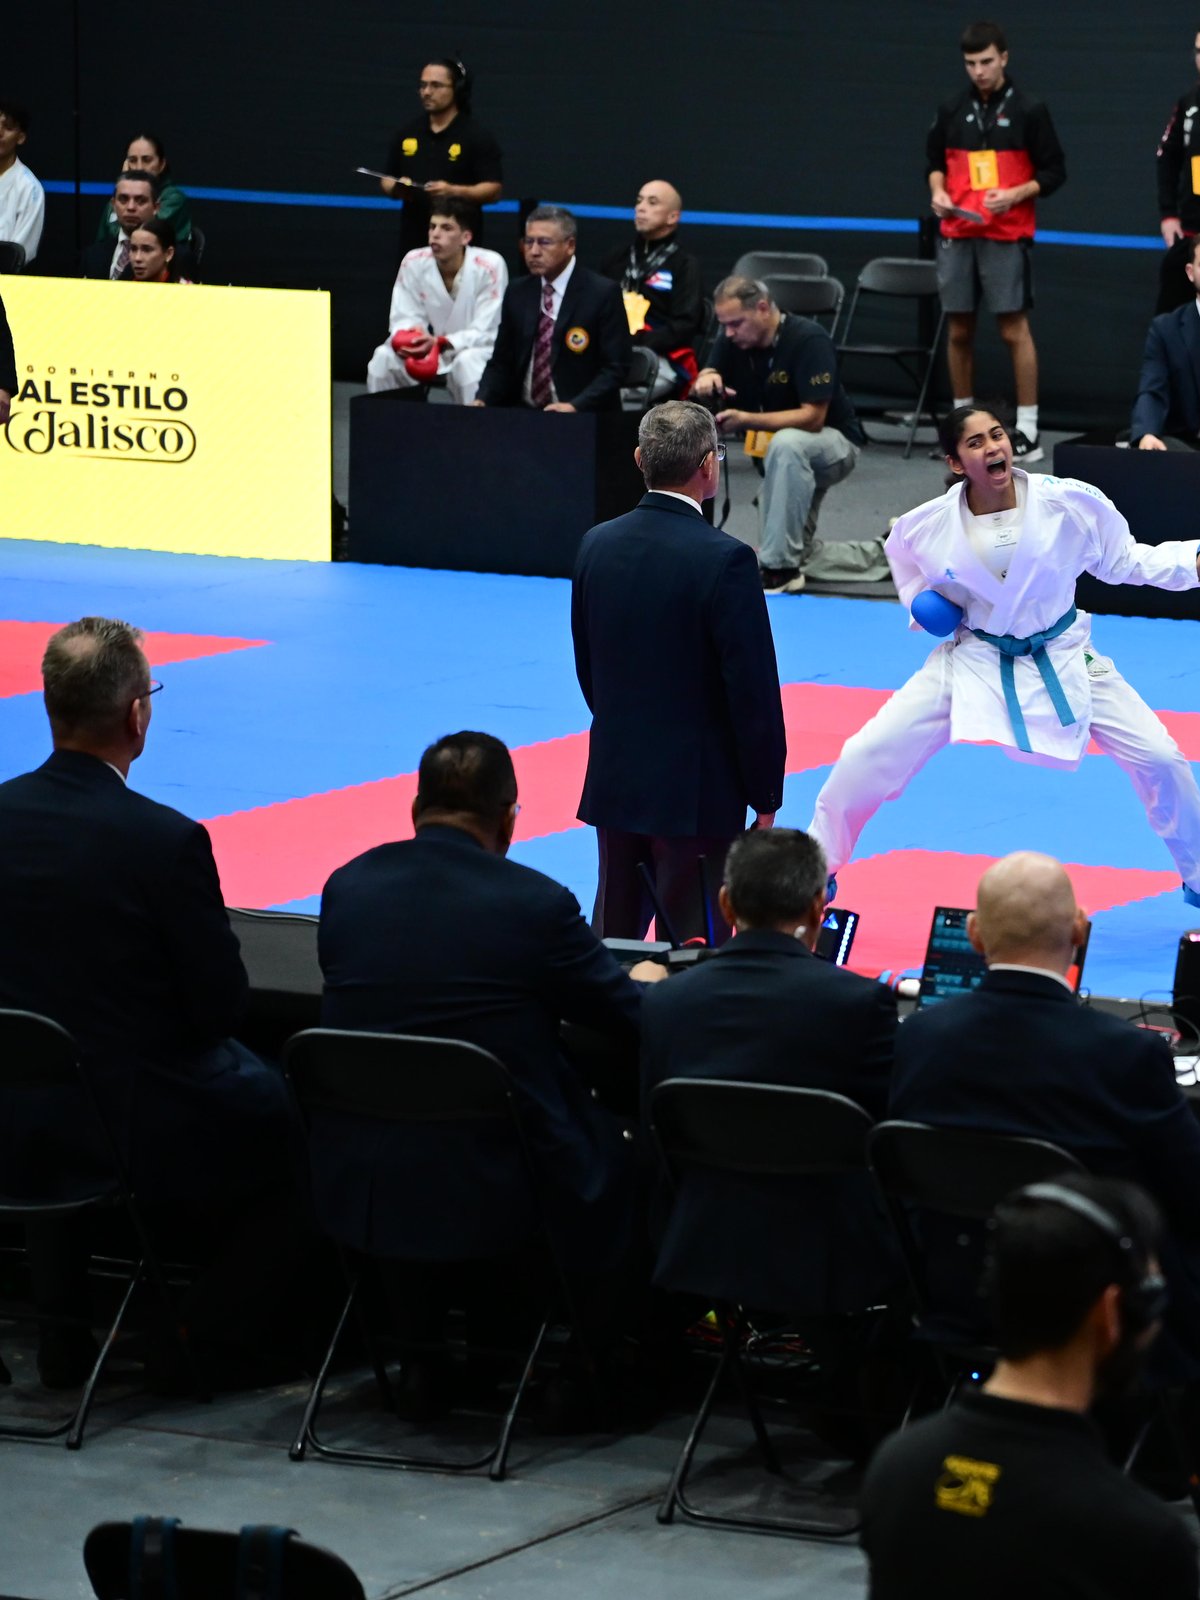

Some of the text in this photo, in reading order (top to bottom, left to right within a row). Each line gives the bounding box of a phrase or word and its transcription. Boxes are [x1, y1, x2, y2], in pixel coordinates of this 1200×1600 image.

[27, 365, 180, 381] GOBIERNO
[18, 379, 188, 411] AL ESTILO
[5, 410, 190, 456] Jalisco
